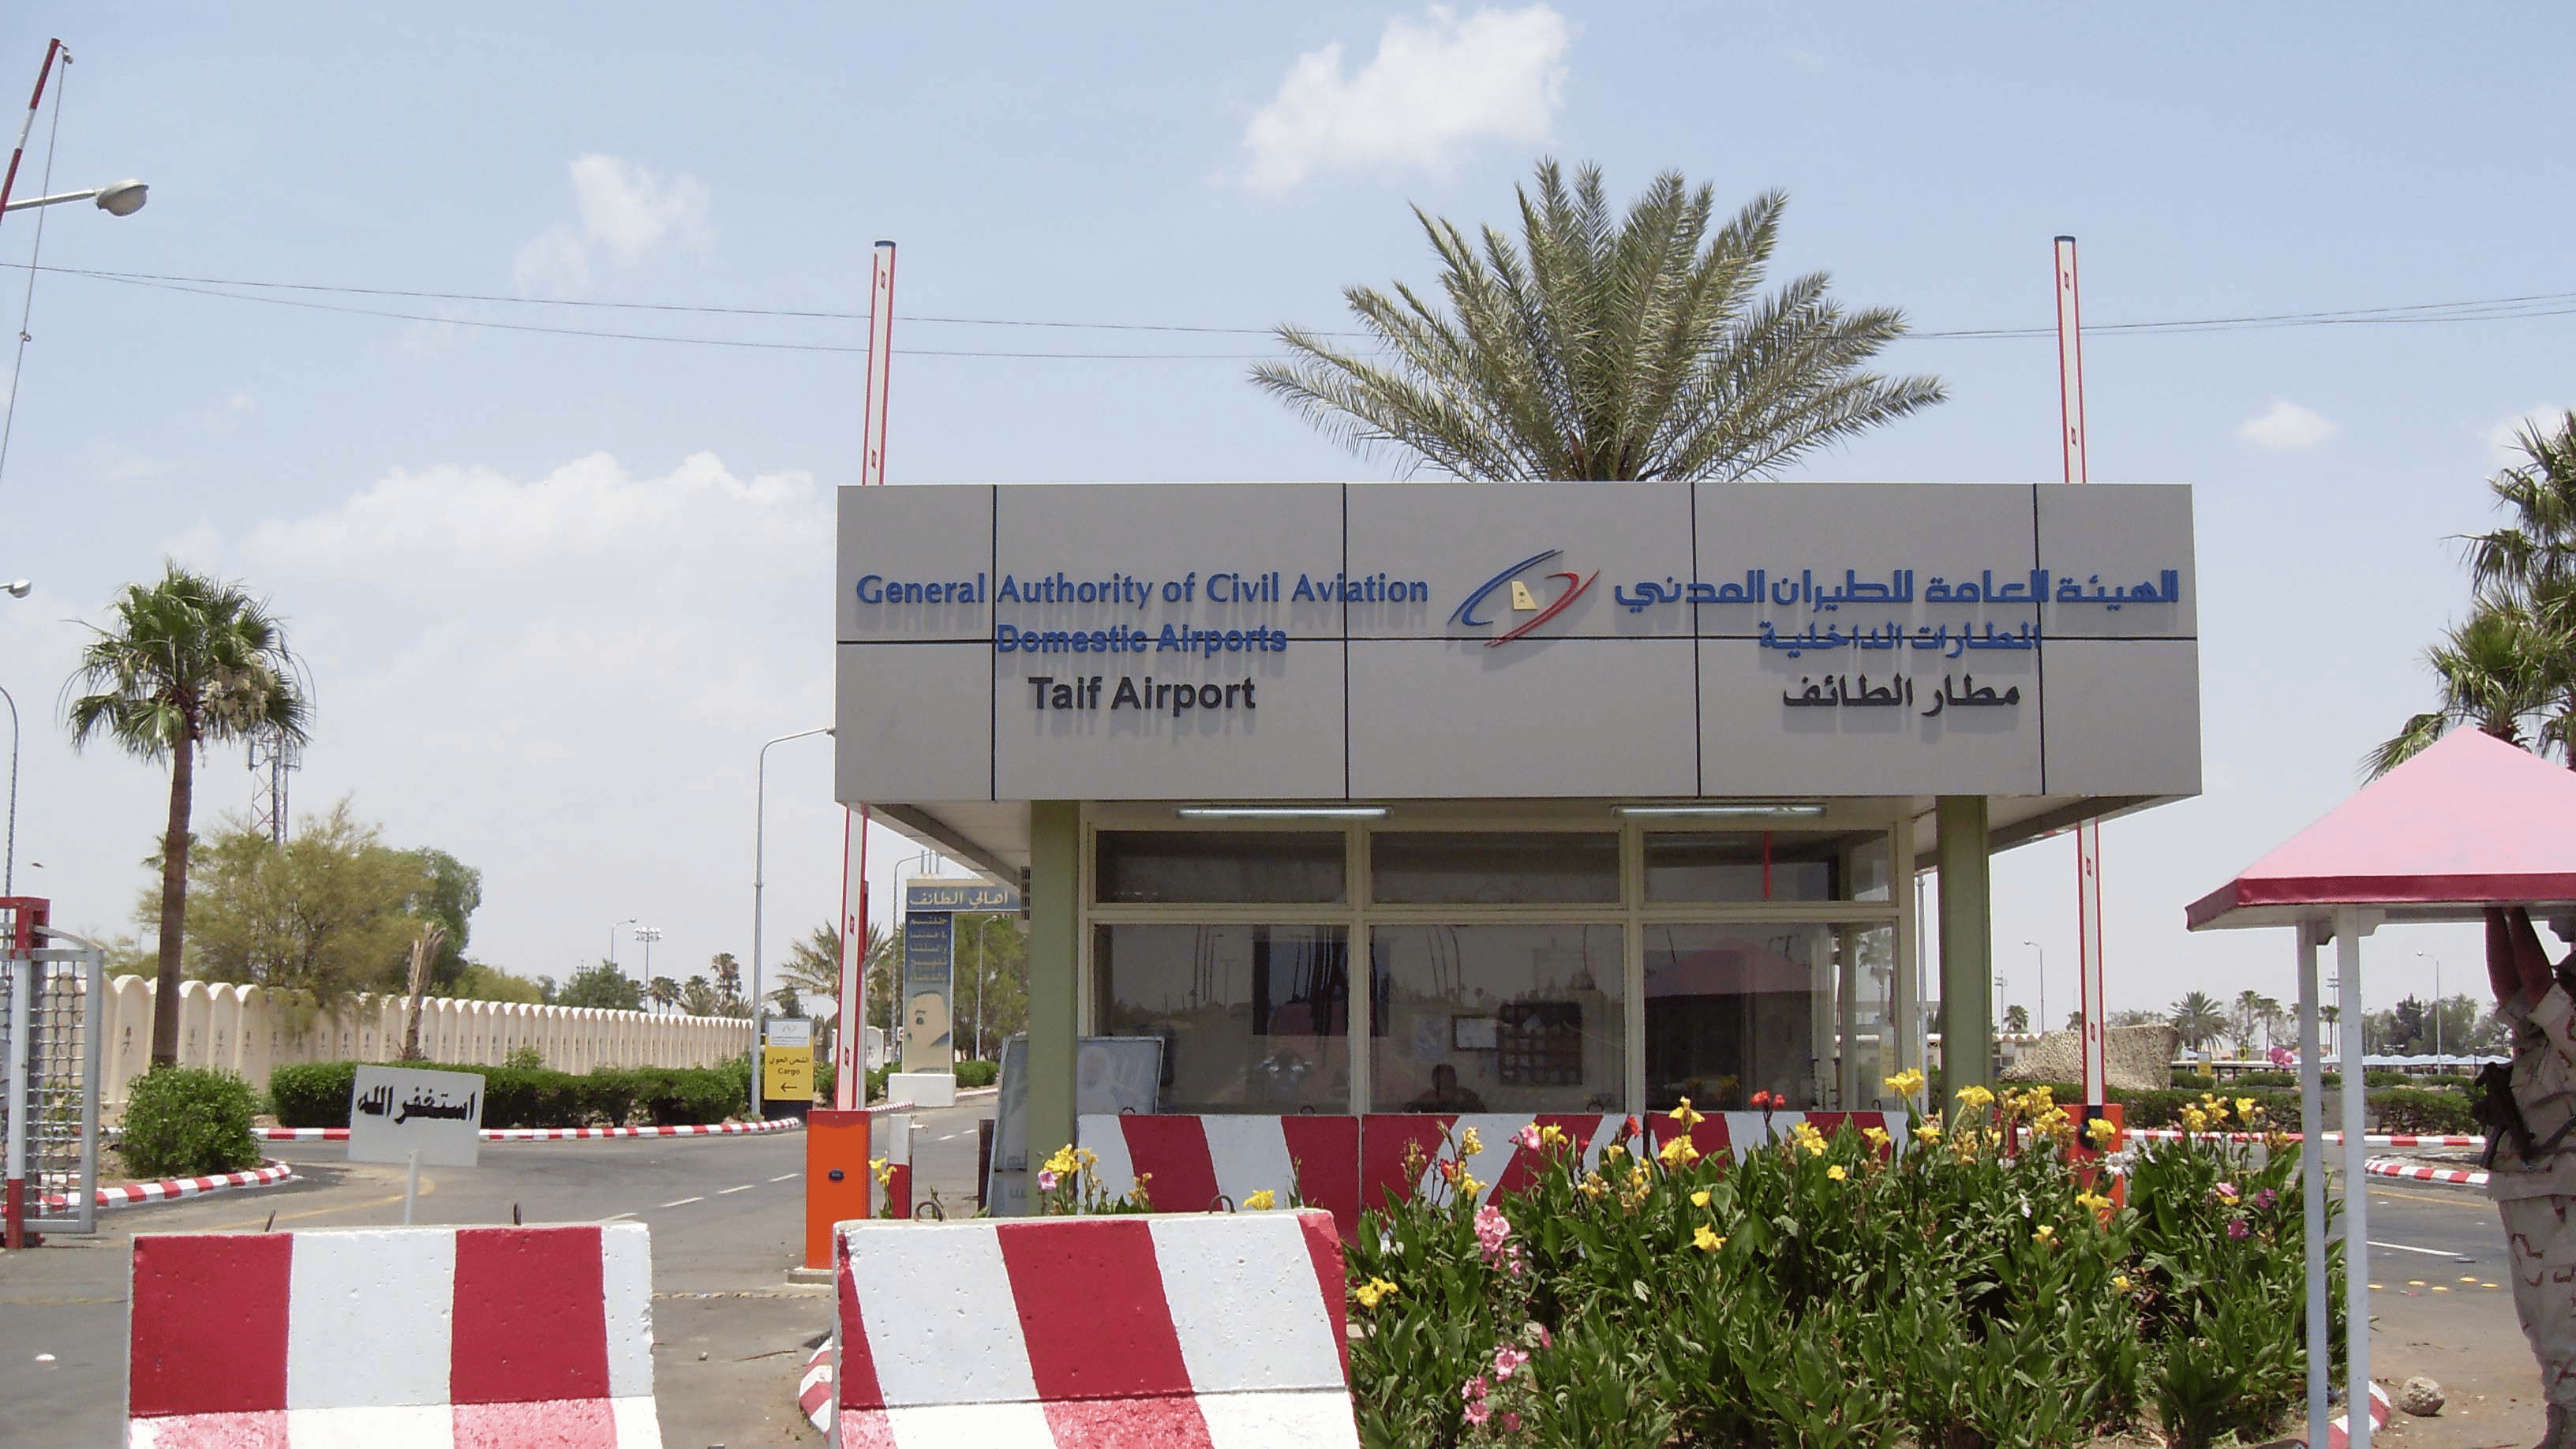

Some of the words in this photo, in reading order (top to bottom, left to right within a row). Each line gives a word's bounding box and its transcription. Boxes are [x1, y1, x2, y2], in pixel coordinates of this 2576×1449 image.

[856, 572, 986, 605] General
[998, 571, 1154, 608] Authority
[1163, 571, 1196, 604] of
[1206, 571, 1279, 604] Civil
[1291, 571, 1428, 603] Aviation
[1615, 569, 1766, 613] المدني
[1772, 568, 1915, 612] للطيران
[1926, 567, 2050, 605] العامة
[2057, 569, 2179, 612] الهيئة
[995, 624, 1148, 653] Domestic
[1156, 623, 1288, 658] Airports
[1759, 621, 1906, 659] الداخلية
[1911, 621, 2042, 659] المطارات
[1028, 676, 1103, 710] Taif
[1110, 676, 1256, 718] Airport
[1783, 672, 1915, 708] الطائف
[1921, 673, 2021, 717] مطار
[909, 890, 964, 905] الطائف
[777, 1067, 800, 1076] Cargo
[358, 1085, 394, 1118] الله
[394, 1086, 476, 1125] استغفر
